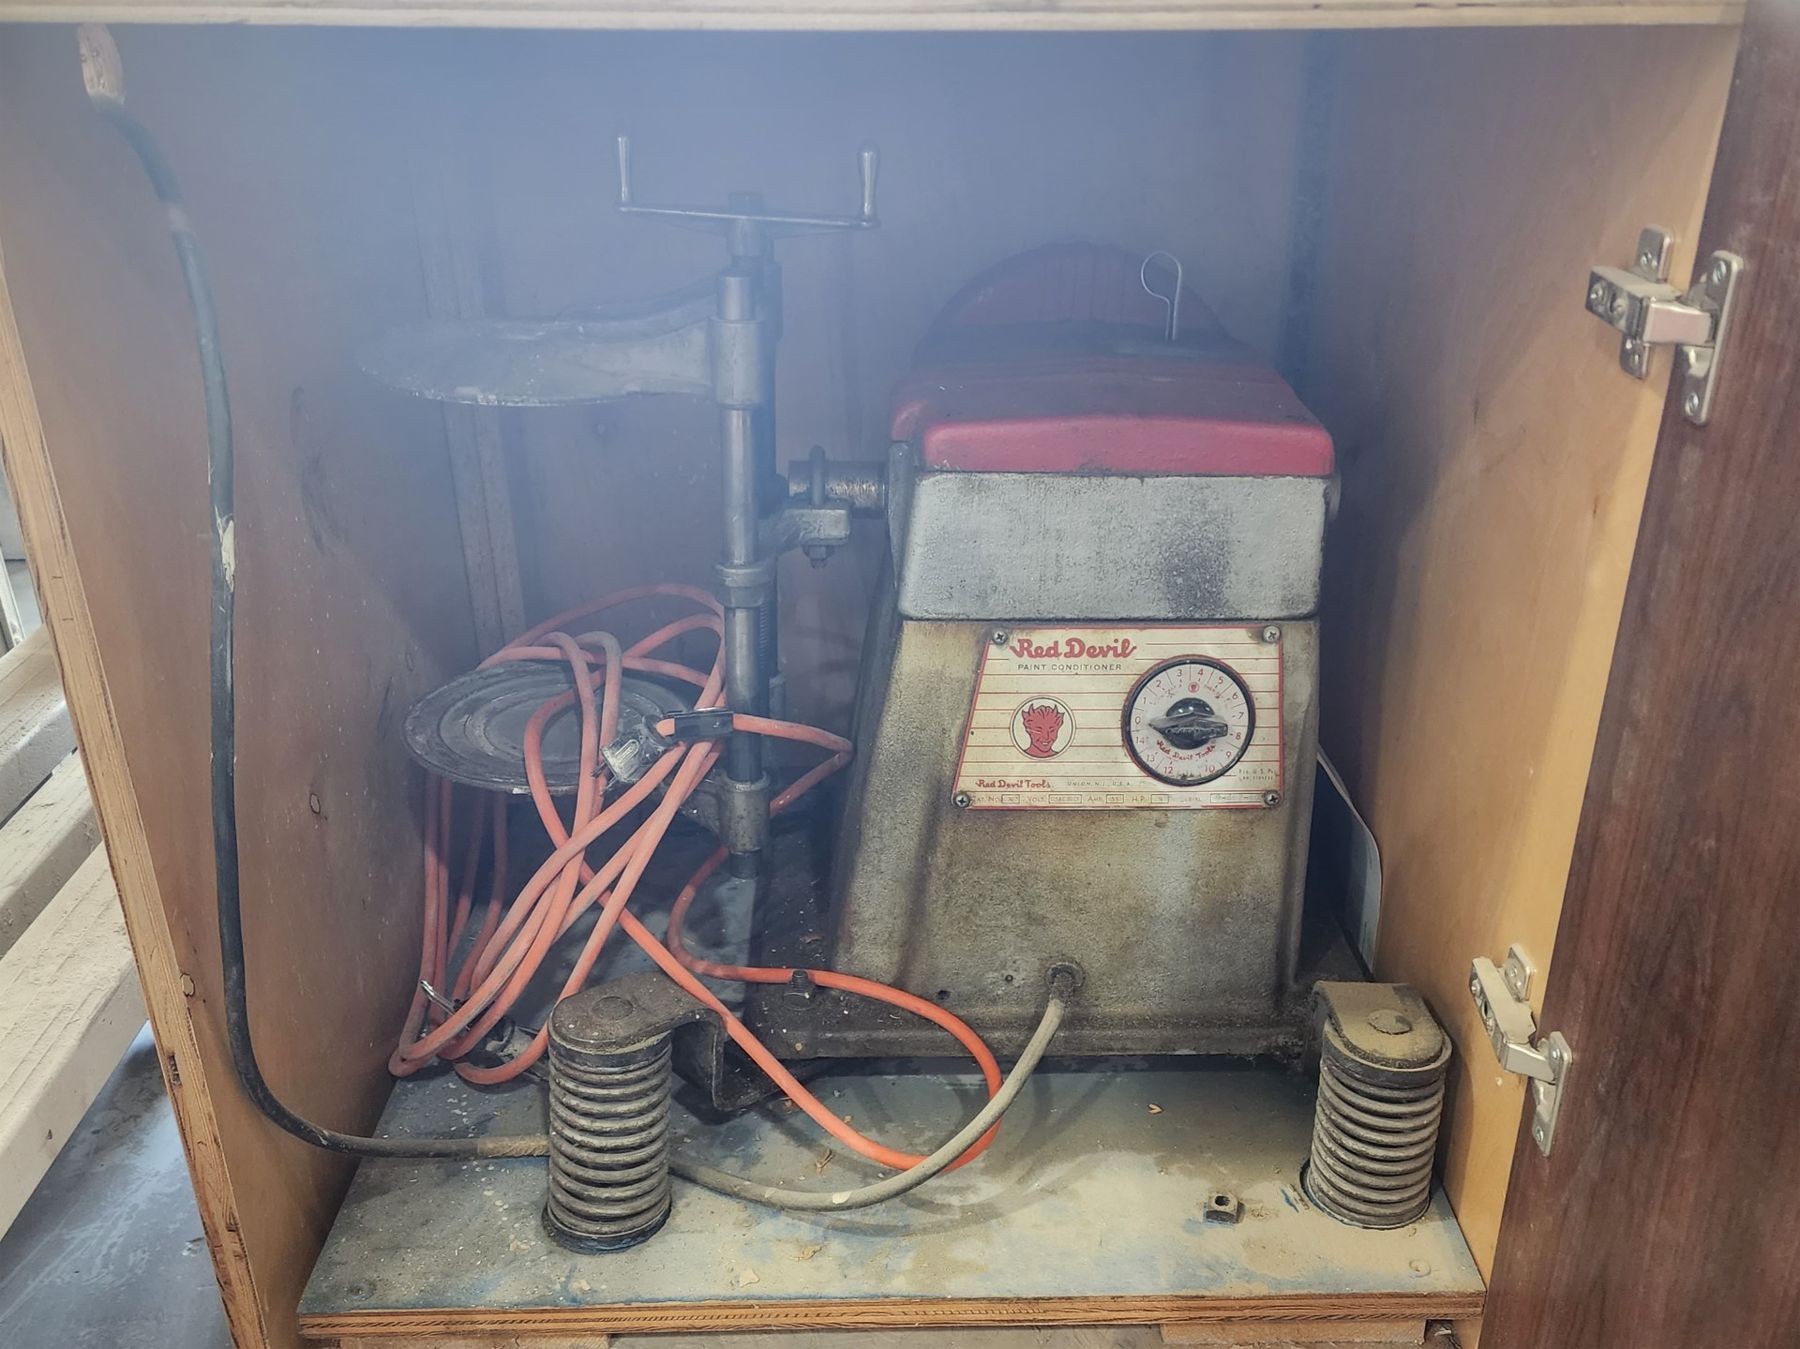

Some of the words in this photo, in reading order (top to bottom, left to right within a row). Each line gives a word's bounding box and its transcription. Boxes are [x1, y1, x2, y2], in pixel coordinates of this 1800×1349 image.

[1009, 638, 1062, 658] Red
[1063, 637, 1137, 658] Devil
[1017, 663, 1046, 671] PAINT
[1051, 663, 1122, 671] CONDITIONER
[1225, 751, 1232, 759] 9
[1164, 766, 1173, 774] 12
[1204, 765, 1215, 773] 10
[975, 780, 996, 788] Red
[997, 779, 1023, 789] Devil
